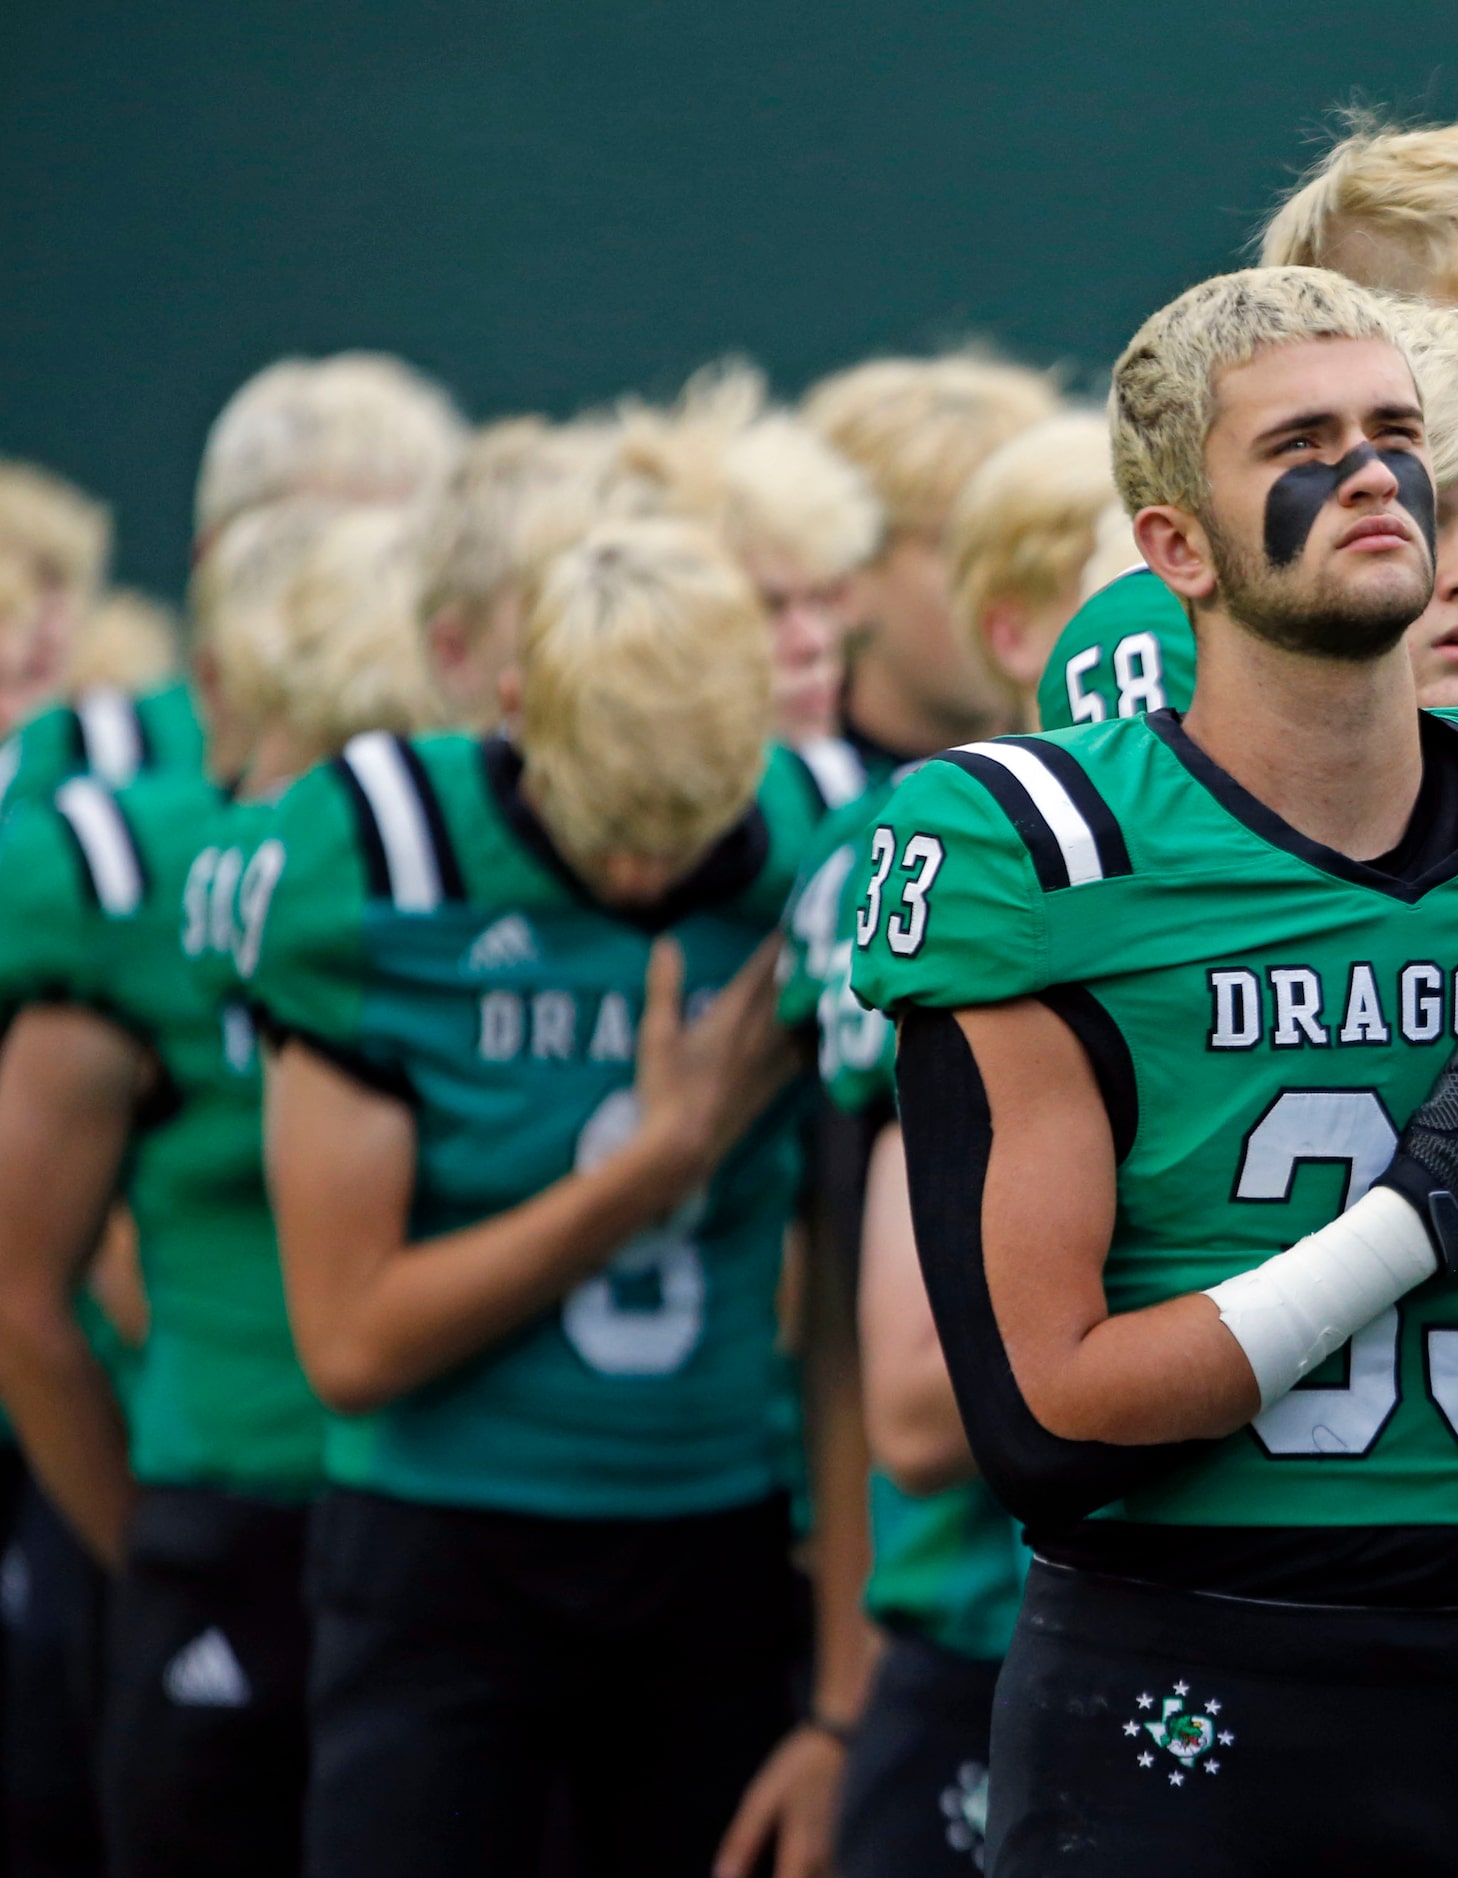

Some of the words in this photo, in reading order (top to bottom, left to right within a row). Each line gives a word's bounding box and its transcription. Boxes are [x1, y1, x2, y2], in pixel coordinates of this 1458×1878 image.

[1065, 630, 1166, 725] 58
[854, 824, 946, 958] 33
[478, 988, 712, 1062] DRA
